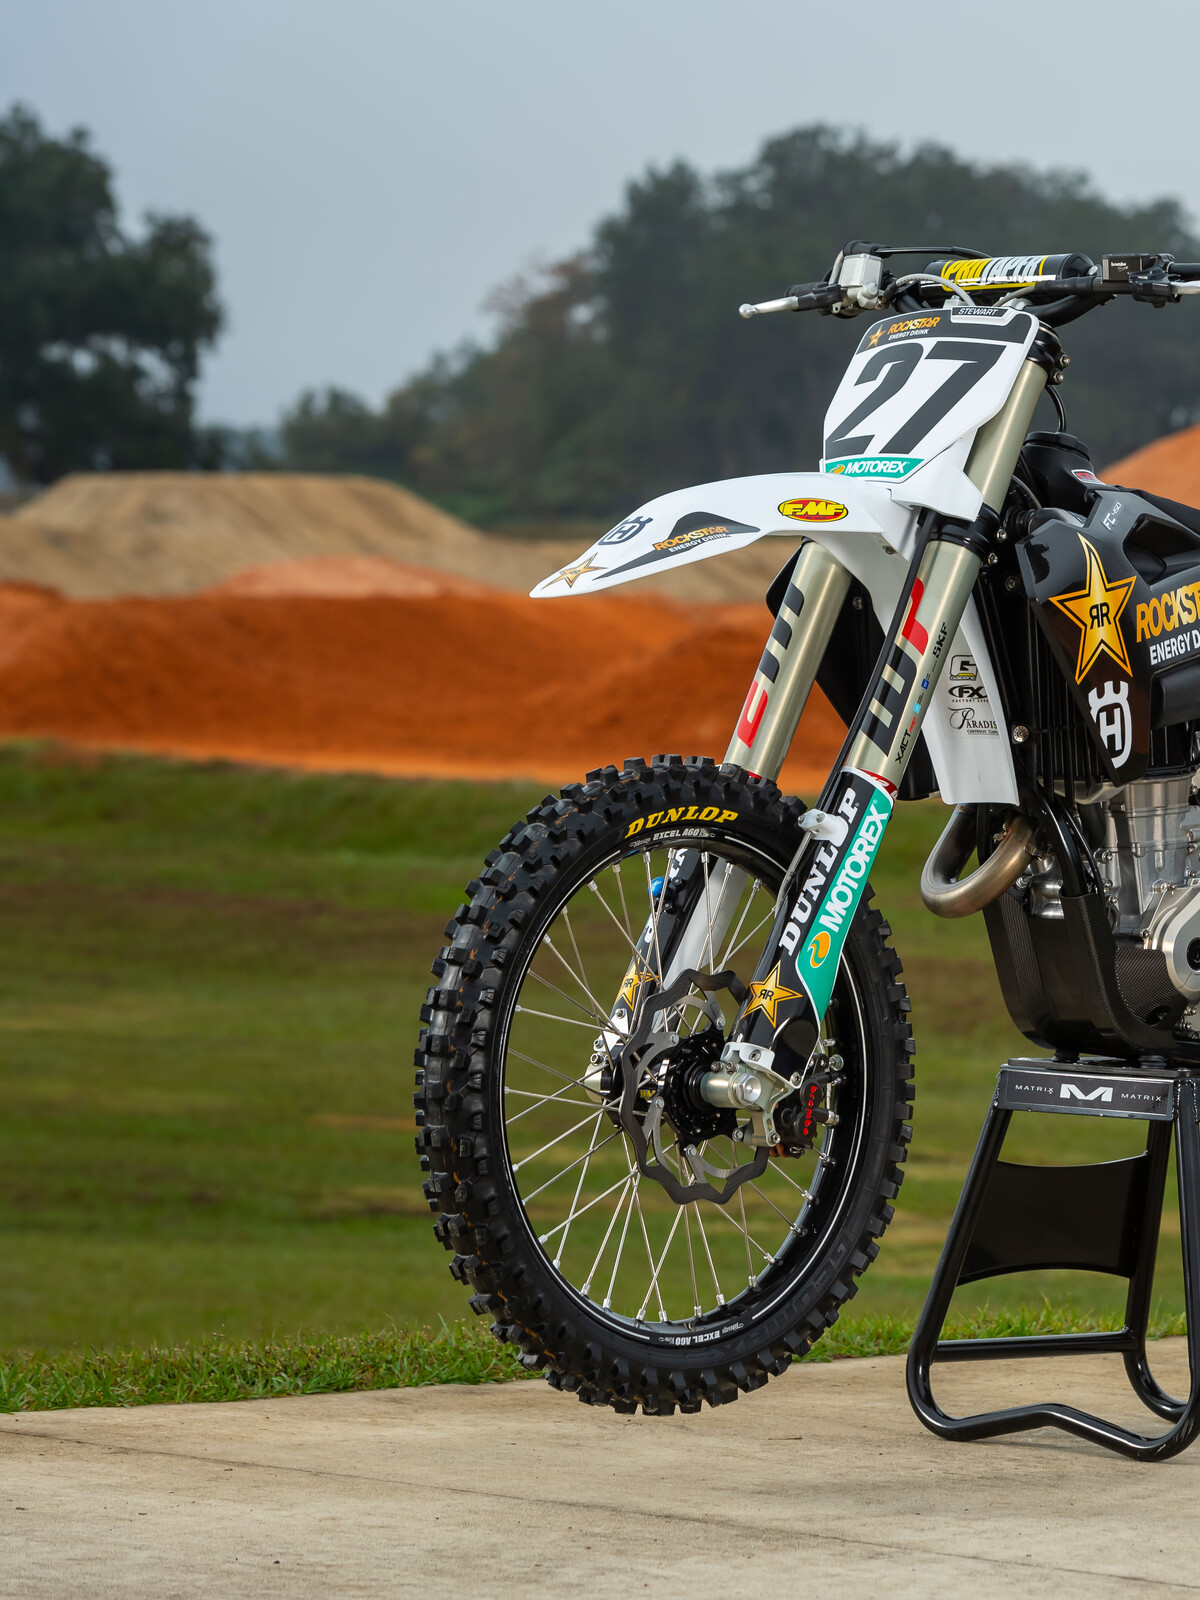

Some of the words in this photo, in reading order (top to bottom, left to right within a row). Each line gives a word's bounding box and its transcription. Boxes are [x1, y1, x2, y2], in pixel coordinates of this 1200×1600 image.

[958, 307, 999, 317] STEWART
[887, 316, 941, 335] ROCKSTAR
[888, 330, 910, 341] ENERGY
[909, 328, 929, 337] DRINK
[825, 341, 1007, 460] 27
[844, 461, 906, 474] MOTOREX
[782, 501, 844, 516] FMF
[652, 526, 729, 551] ROCKSTAR
[668, 538, 702, 553] ENERGY
[702, 532, 728, 544] DRINK
[932, 622, 948, 658] SKF
[1149, 632, 1191, 666] ENERGY
[948, 707, 997, 729] PARADIS
[625, 806, 738, 838] DUNLOP
[653, 830, 681, 841] EXCEL
[682, 828, 700, 837] A60
[779, 787, 856, 956] DUNLP
[819, 803, 888, 933] MOTOREX
[1015, 1084, 1054, 1094] MATRIX
[1121, 1093, 1161, 1101] MATRIX
[803, 1085, 818, 1135] brembo
[675, 1337, 691, 1345] A60
[693, 1330, 720, 1343] EXCEL
